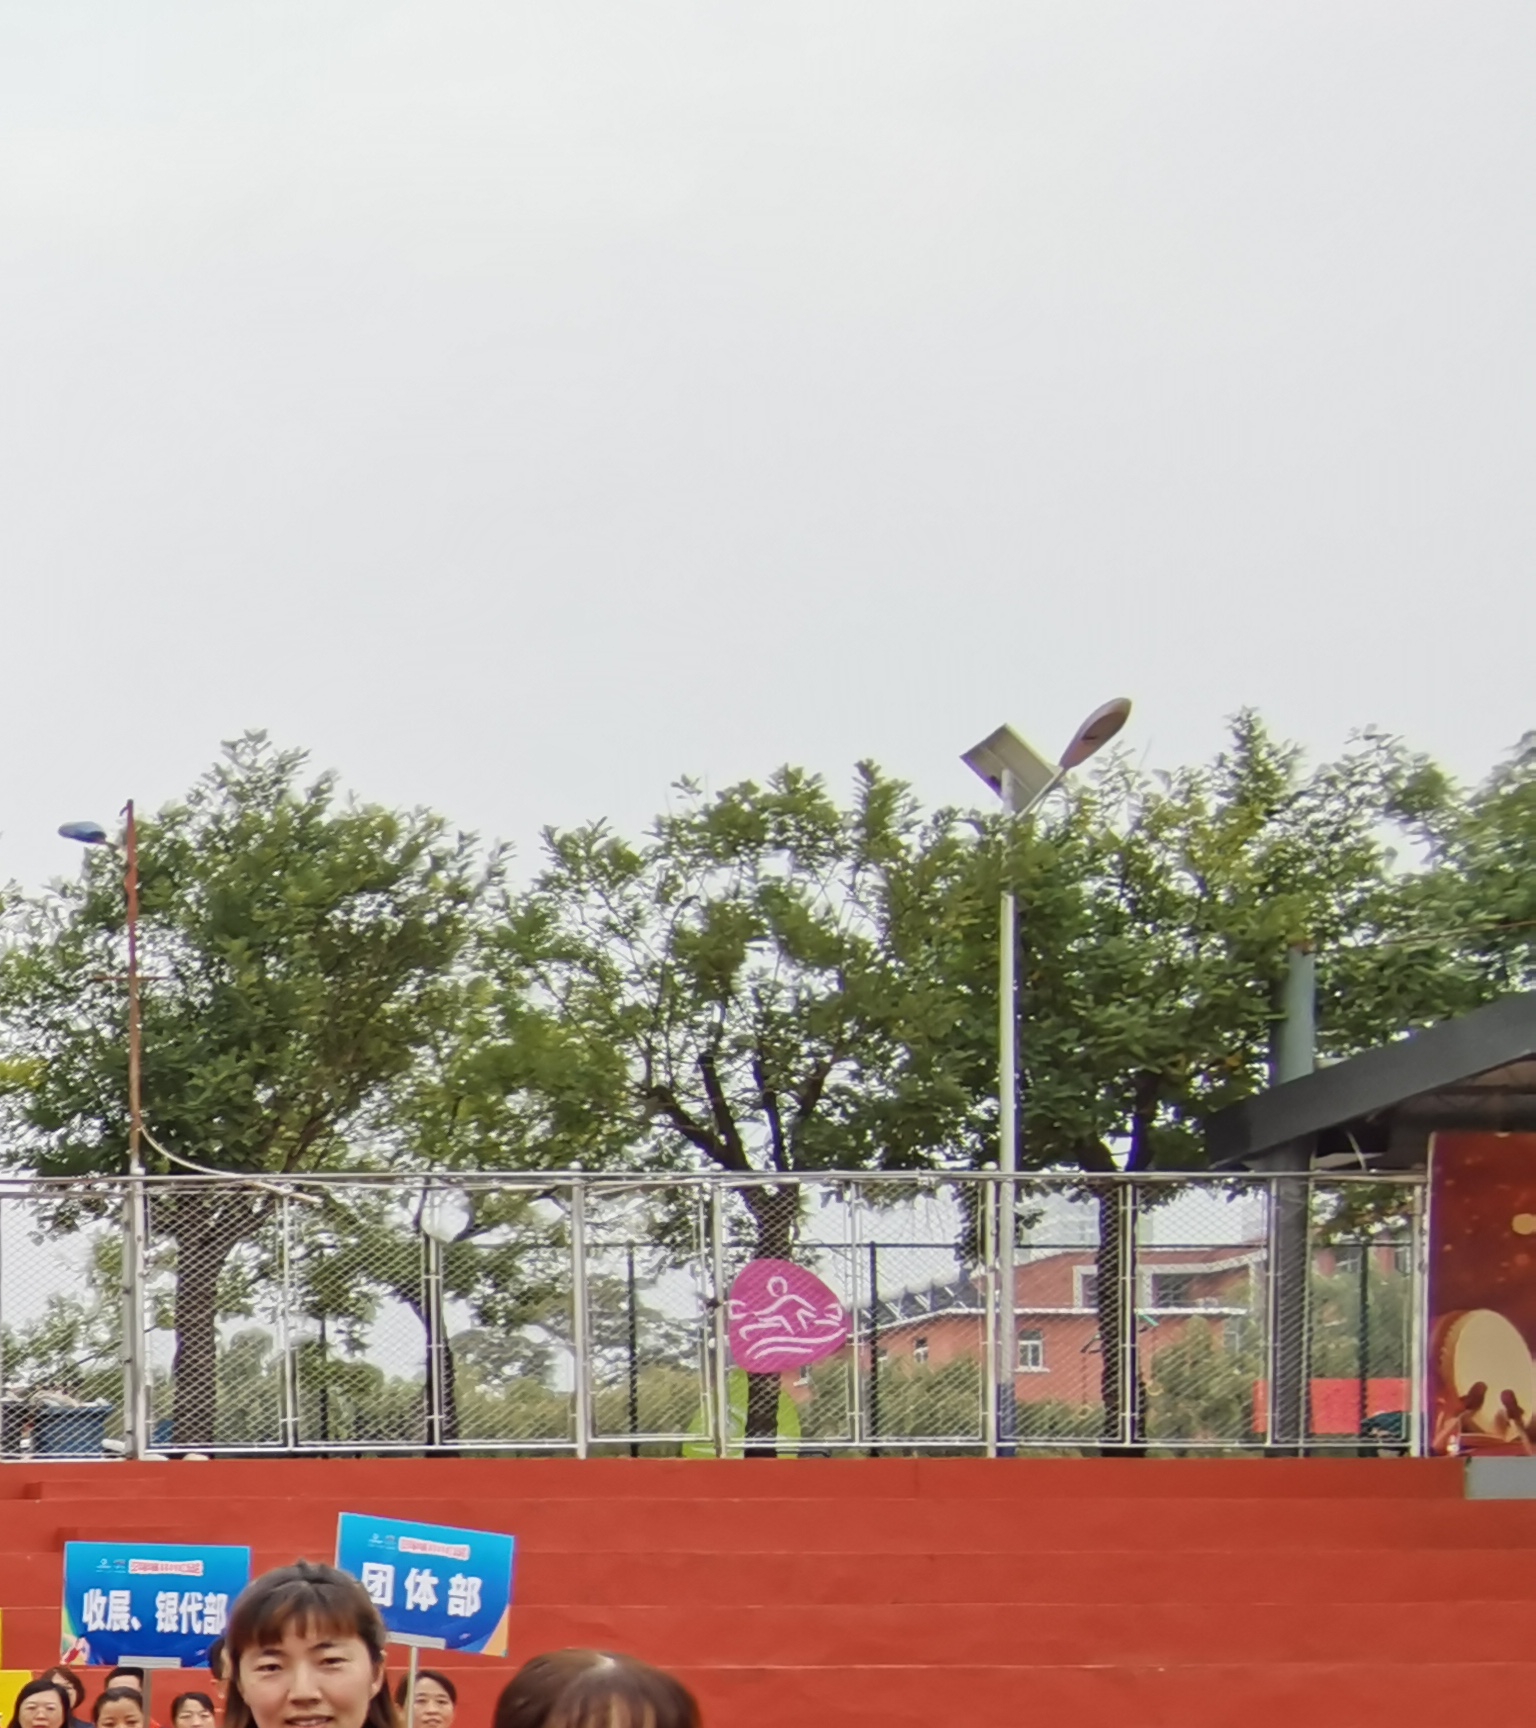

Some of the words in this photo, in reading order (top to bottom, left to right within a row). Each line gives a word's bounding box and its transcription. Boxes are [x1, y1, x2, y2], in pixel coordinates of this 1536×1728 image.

[81, 1587, 229, 1635] 收展、银代部
[361, 1561, 483, 1618] 团体部
